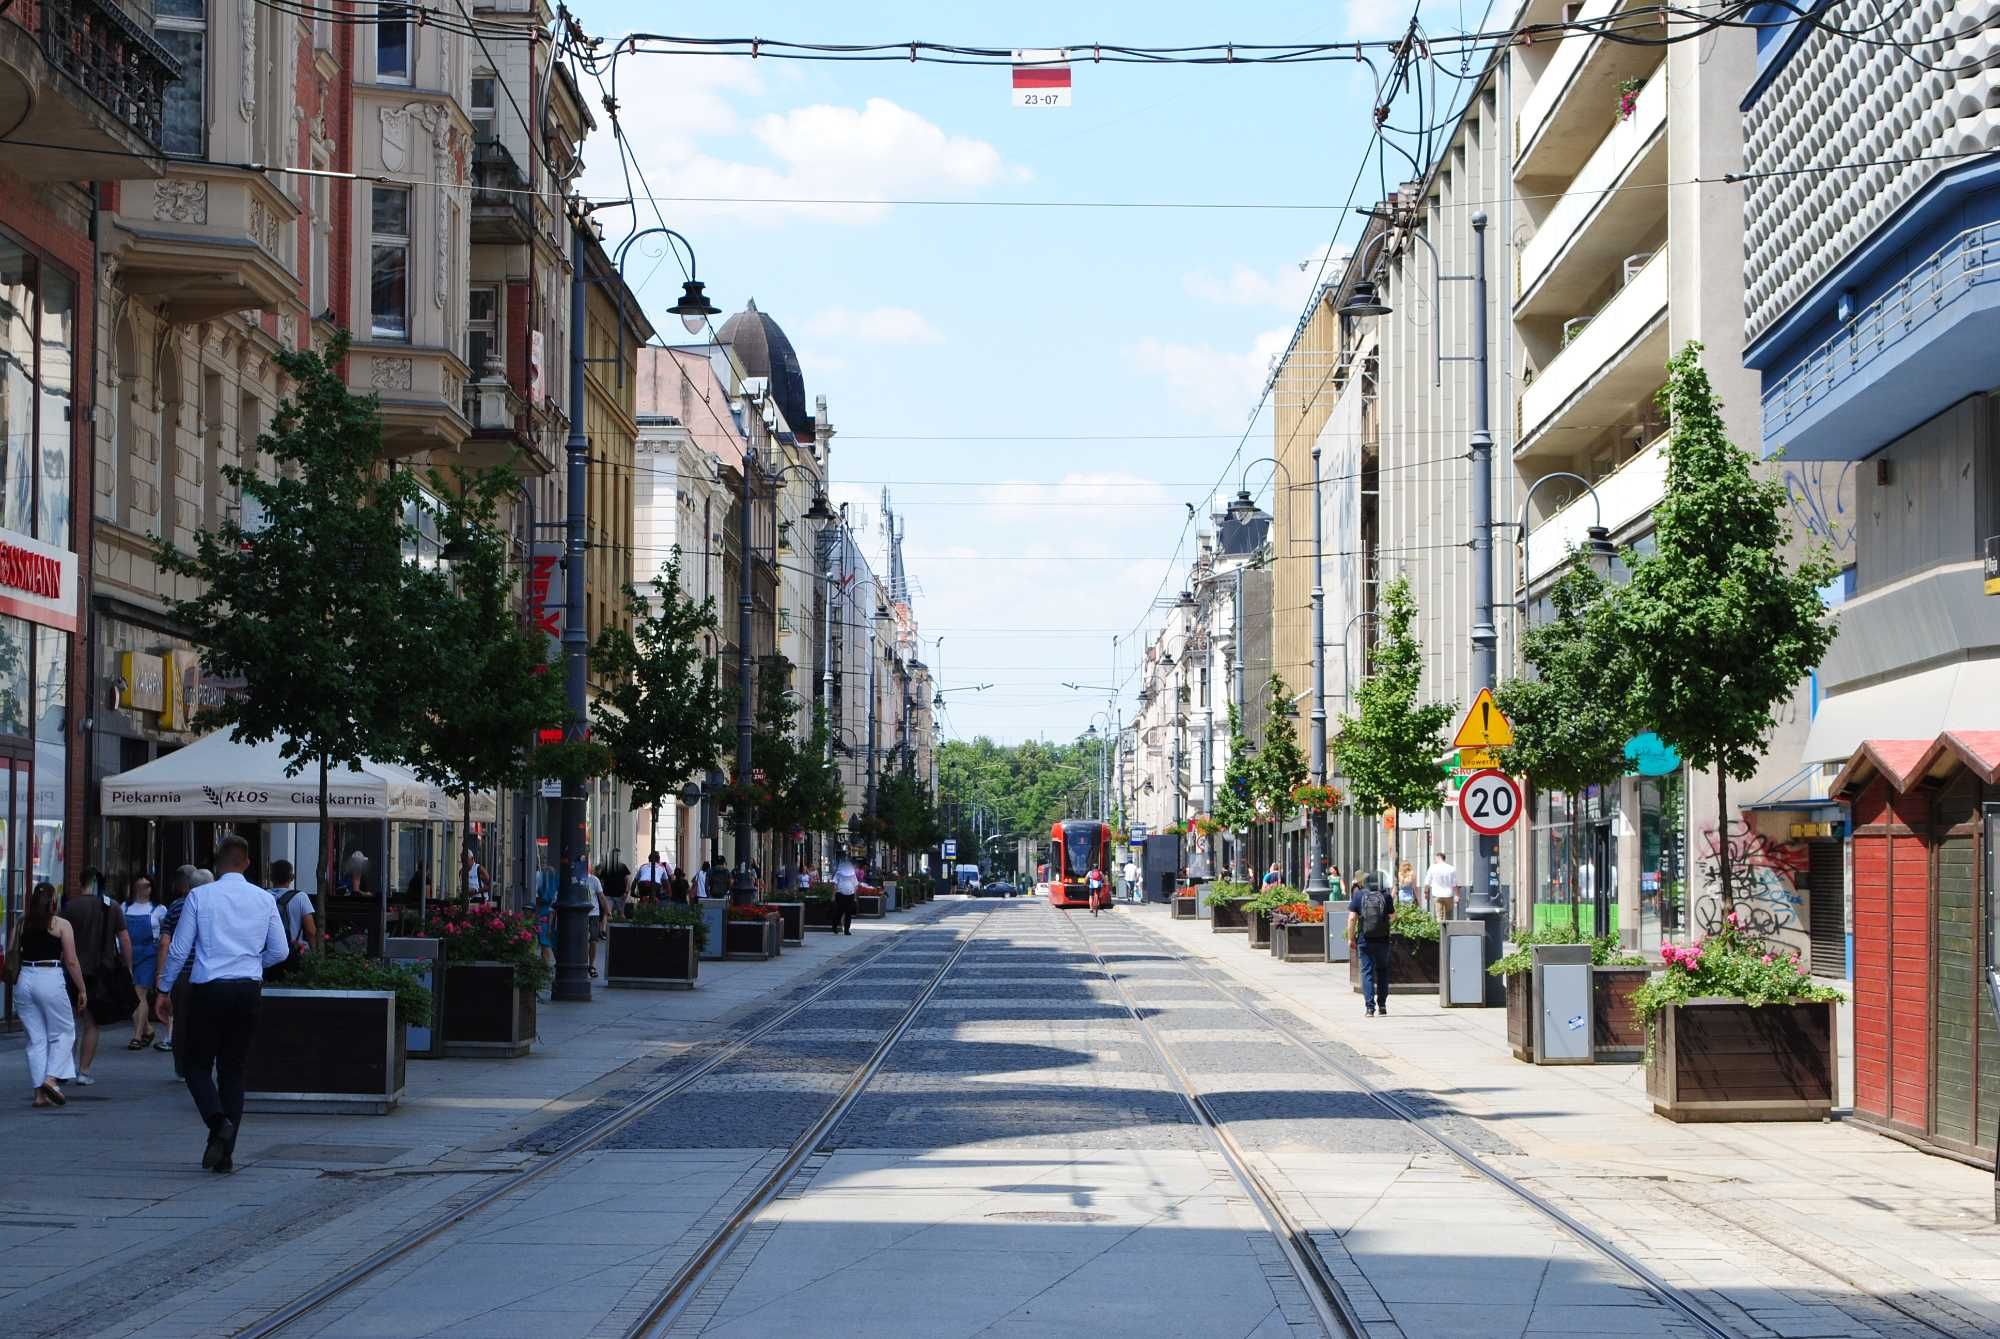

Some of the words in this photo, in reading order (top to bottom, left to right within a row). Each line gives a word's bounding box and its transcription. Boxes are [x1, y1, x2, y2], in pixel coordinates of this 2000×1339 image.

[1024, 94, 1059, 105] 23-07
[112, 791, 181, 803] Piekarnia
[225, 791, 269, 803] KŁOS
[291, 792, 375, 805] Ciaskarnia
[1472, 786, 1512, 818] 20
